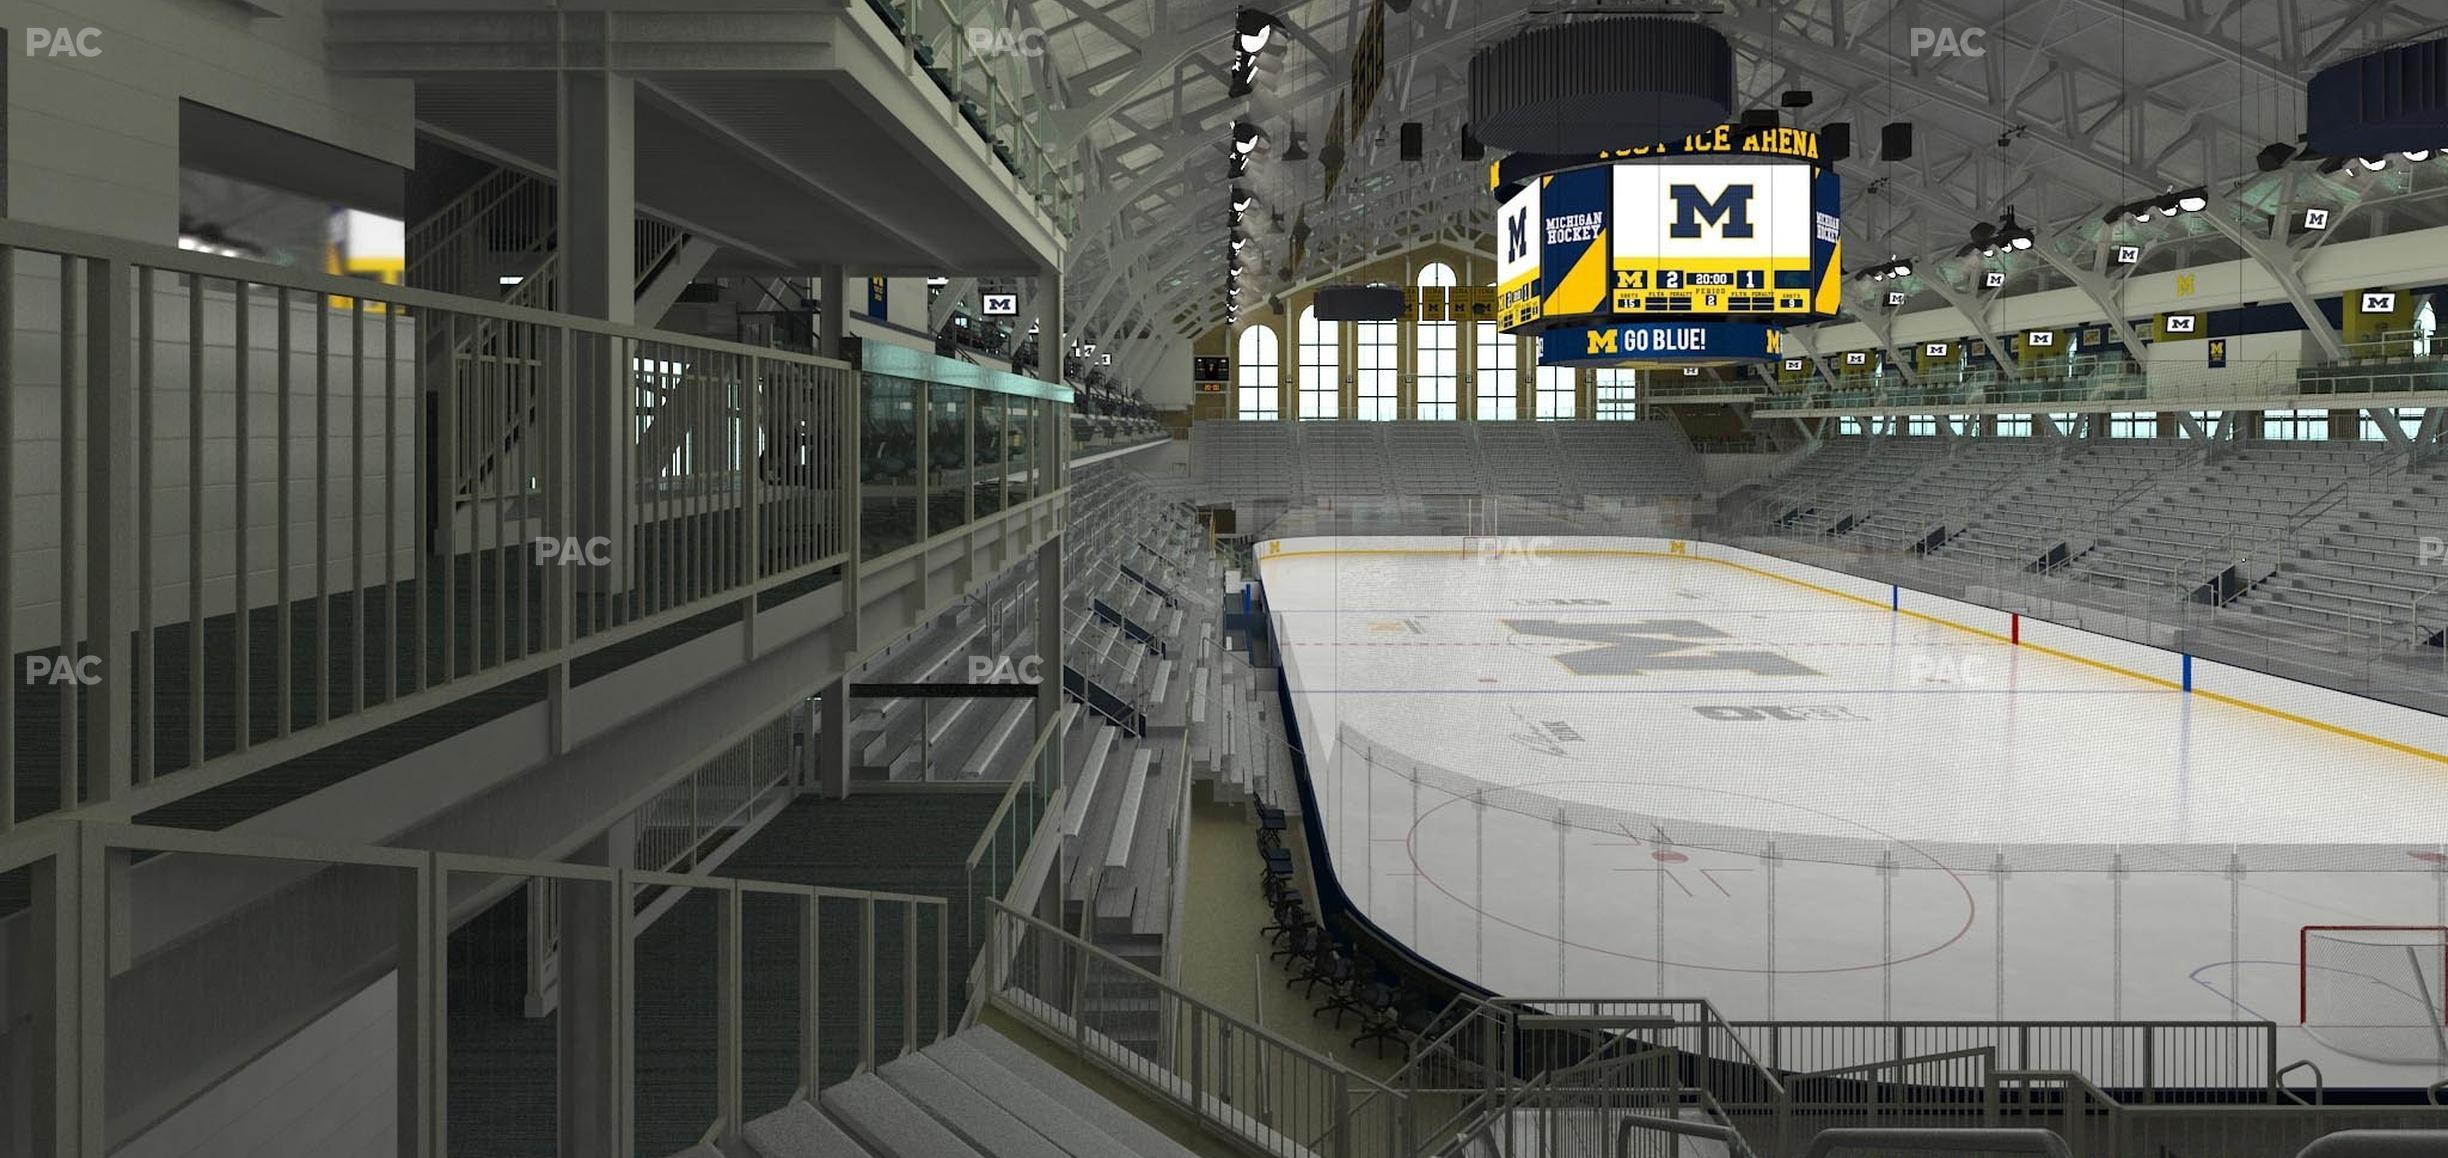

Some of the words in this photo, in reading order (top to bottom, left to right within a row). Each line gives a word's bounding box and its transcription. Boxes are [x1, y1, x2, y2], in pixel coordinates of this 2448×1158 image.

[1670, 184, 1753, 239] M
[1546, 211, 1602, 230] MICHIGAN
[2309, 214, 2324, 225] M
[1508, 206, 1527, 264] M
[1547, 224, 1601, 245] HOCKEY
[2122, 250, 2135, 260] M
[1618, 271, 1643, 288] M
[1666, 271, 1678, 288] 2
[1695, 274, 1727, 285] 20:00
[1745, 271, 1754, 288] 1
[2176, 273, 2196, 297] M
[989, 299, 1011, 311] M
[1624, 299, 1635, 308] 15
[1707, 296, 1715, 305] 2
[2367, 297, 2389, 309] M
[2172, 319, 2190, 328] M
[1586, 328, 1618, 355] M
[1624, 329, 1649, 351] GO
[1653, 328, 1706, 351] BLUE!
[1766, 329, 1780, 354] M
[2033, 334, 2049, 344] M
[1930, 345, 1944, 354] M
